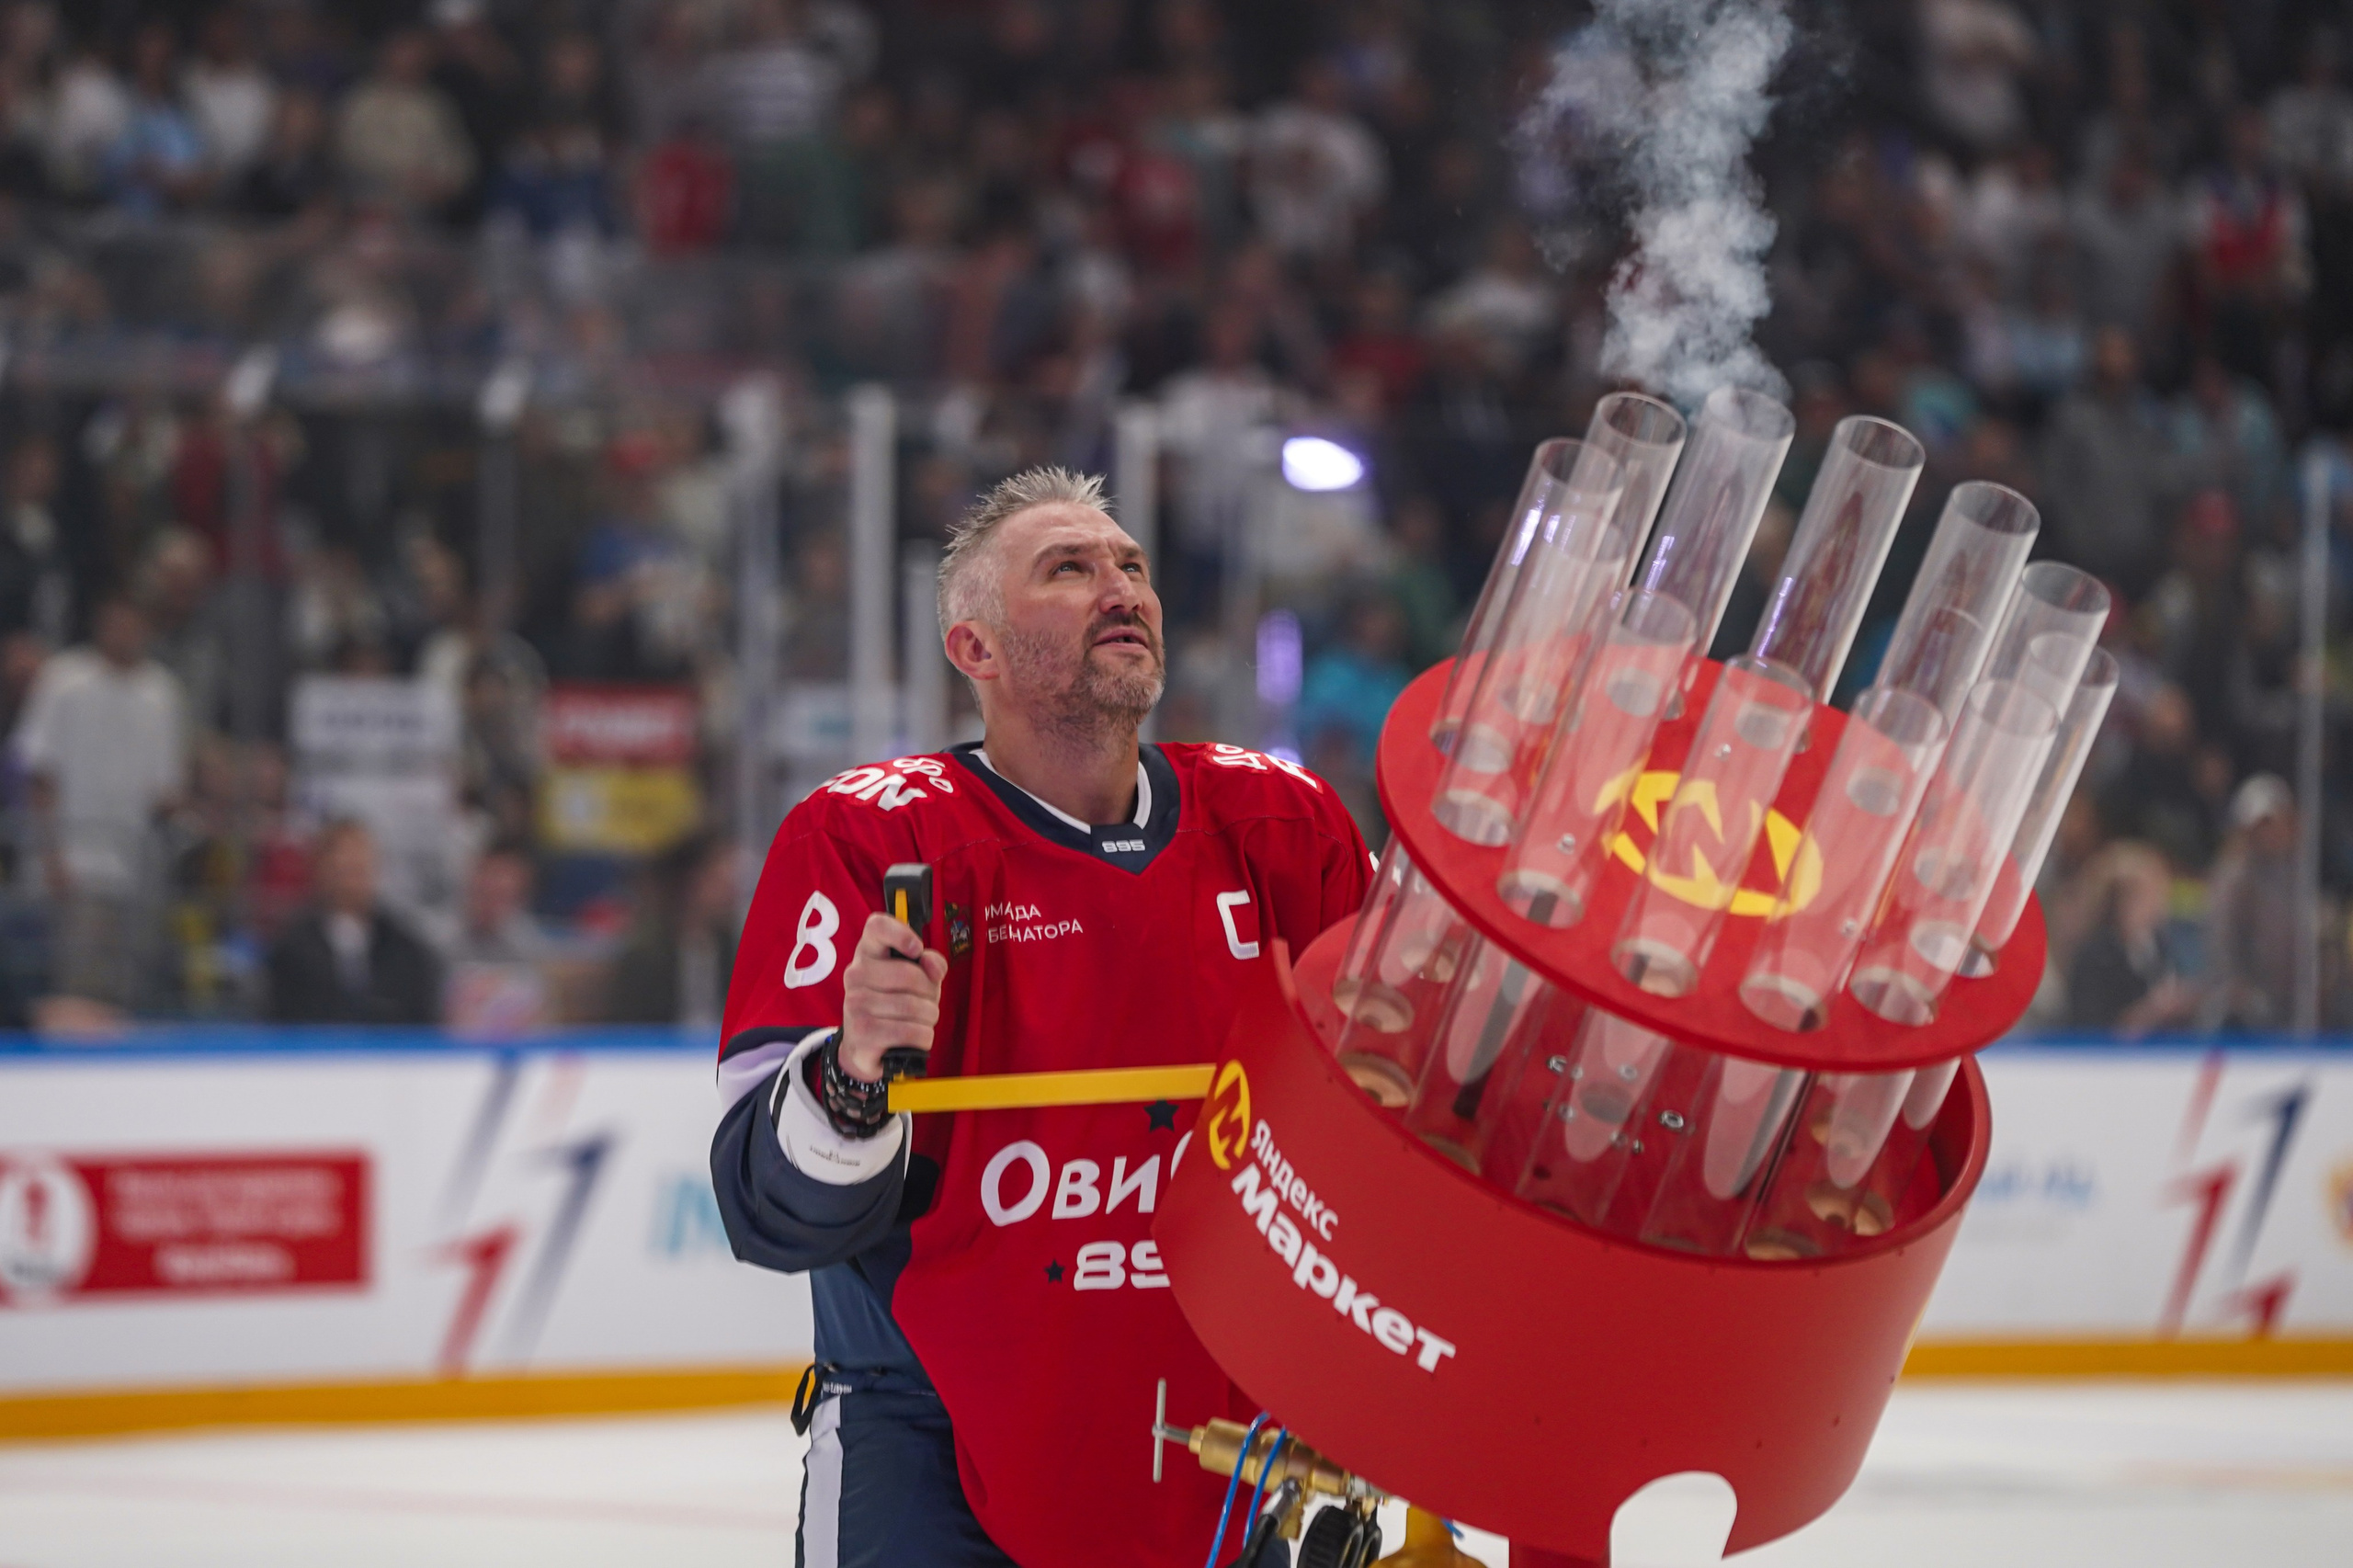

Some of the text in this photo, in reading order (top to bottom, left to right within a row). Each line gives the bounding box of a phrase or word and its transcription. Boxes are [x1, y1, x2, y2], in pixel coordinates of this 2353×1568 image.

[1102, 839, 1145, 853] 895
[784, 890, 840, 989] 8
[1216, 889, 1259, 960] C
[981, 1131, 1193, 1227] Ови
[1251, 1119, 1338, 1242] Яндекс
[1074, 1240, 1171, 1290] 89
[1232, 1162, 1456, 1372] Маркет
